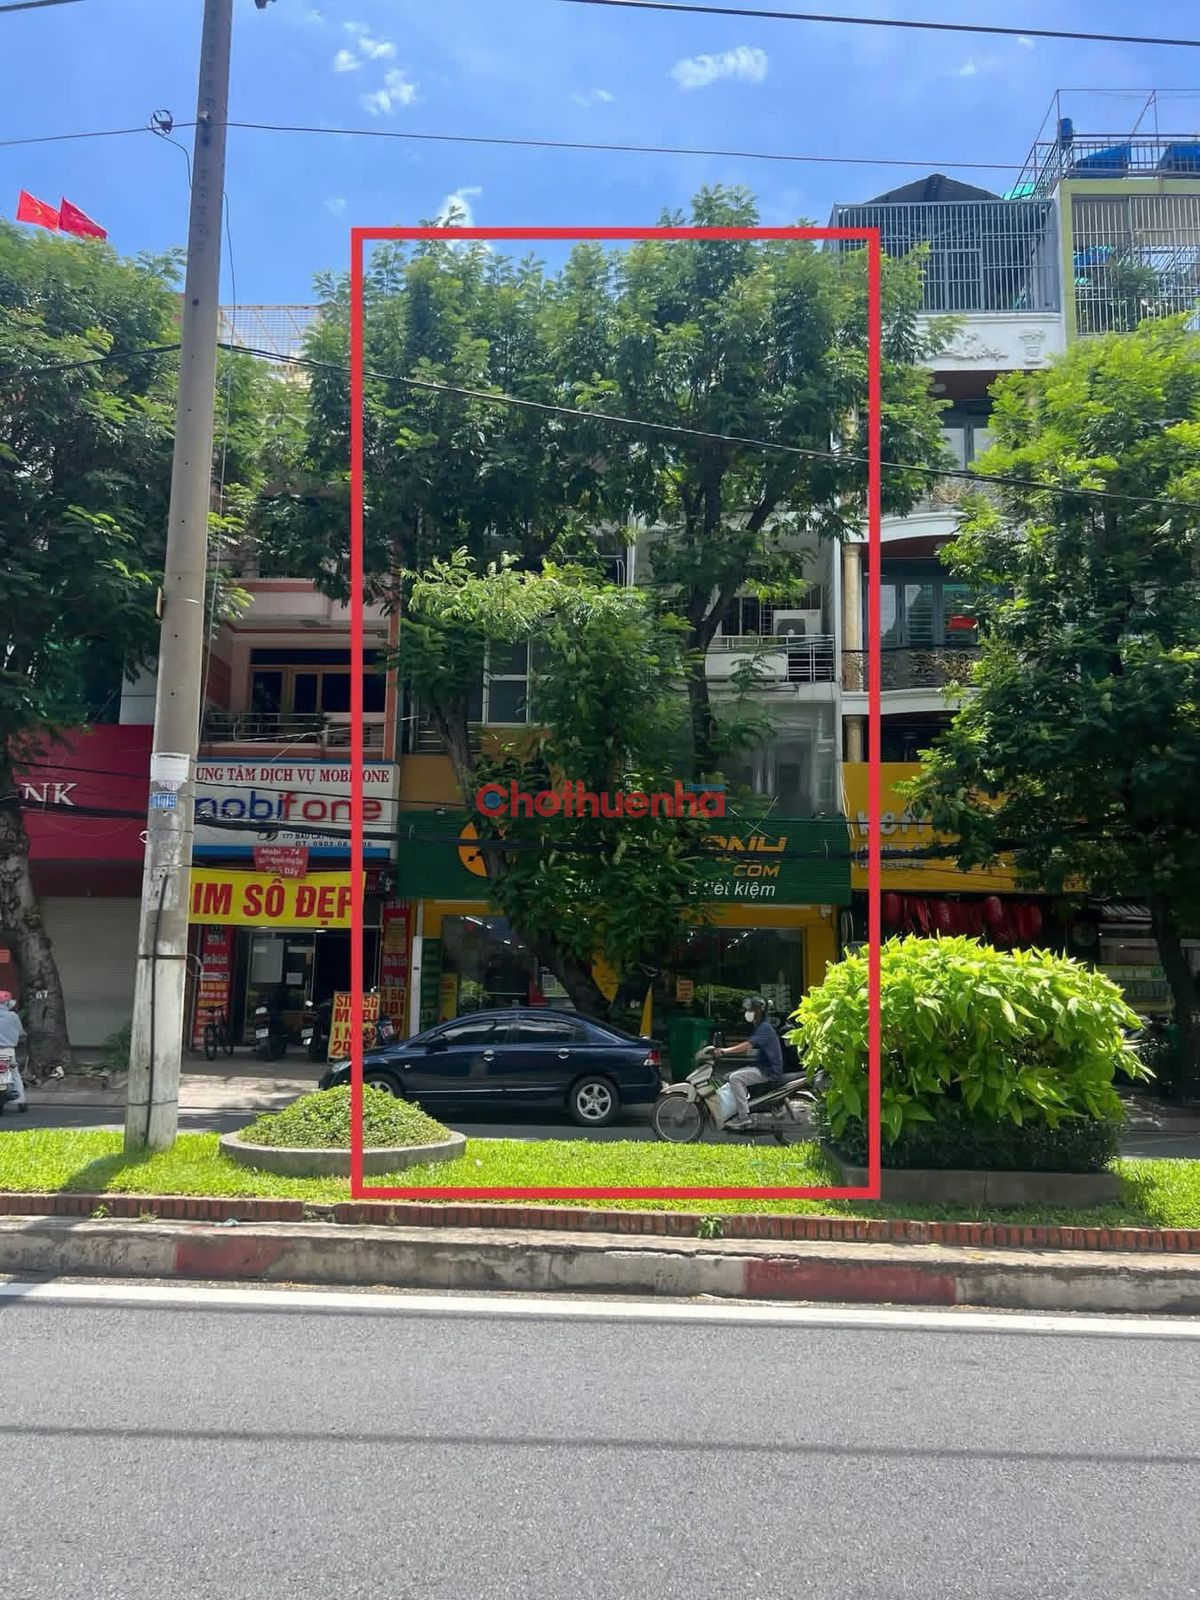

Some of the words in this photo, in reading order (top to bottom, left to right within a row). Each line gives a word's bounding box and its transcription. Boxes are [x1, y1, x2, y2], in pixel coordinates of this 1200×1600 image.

[196, 767, 224, 781] UNG
[227, 764, 256, 781] TÂM
[260, 768, 293, 784] DỊCH
[297, 769, 315, 785] VỤ
[320, 769, 389, 783] MOBIONE
[733, 864, 780, 878] COM
[193, 883, 233, 914] IM
[735, 881, 776, 899] kiệm
[334, 1009, 378, 1024] MBI
